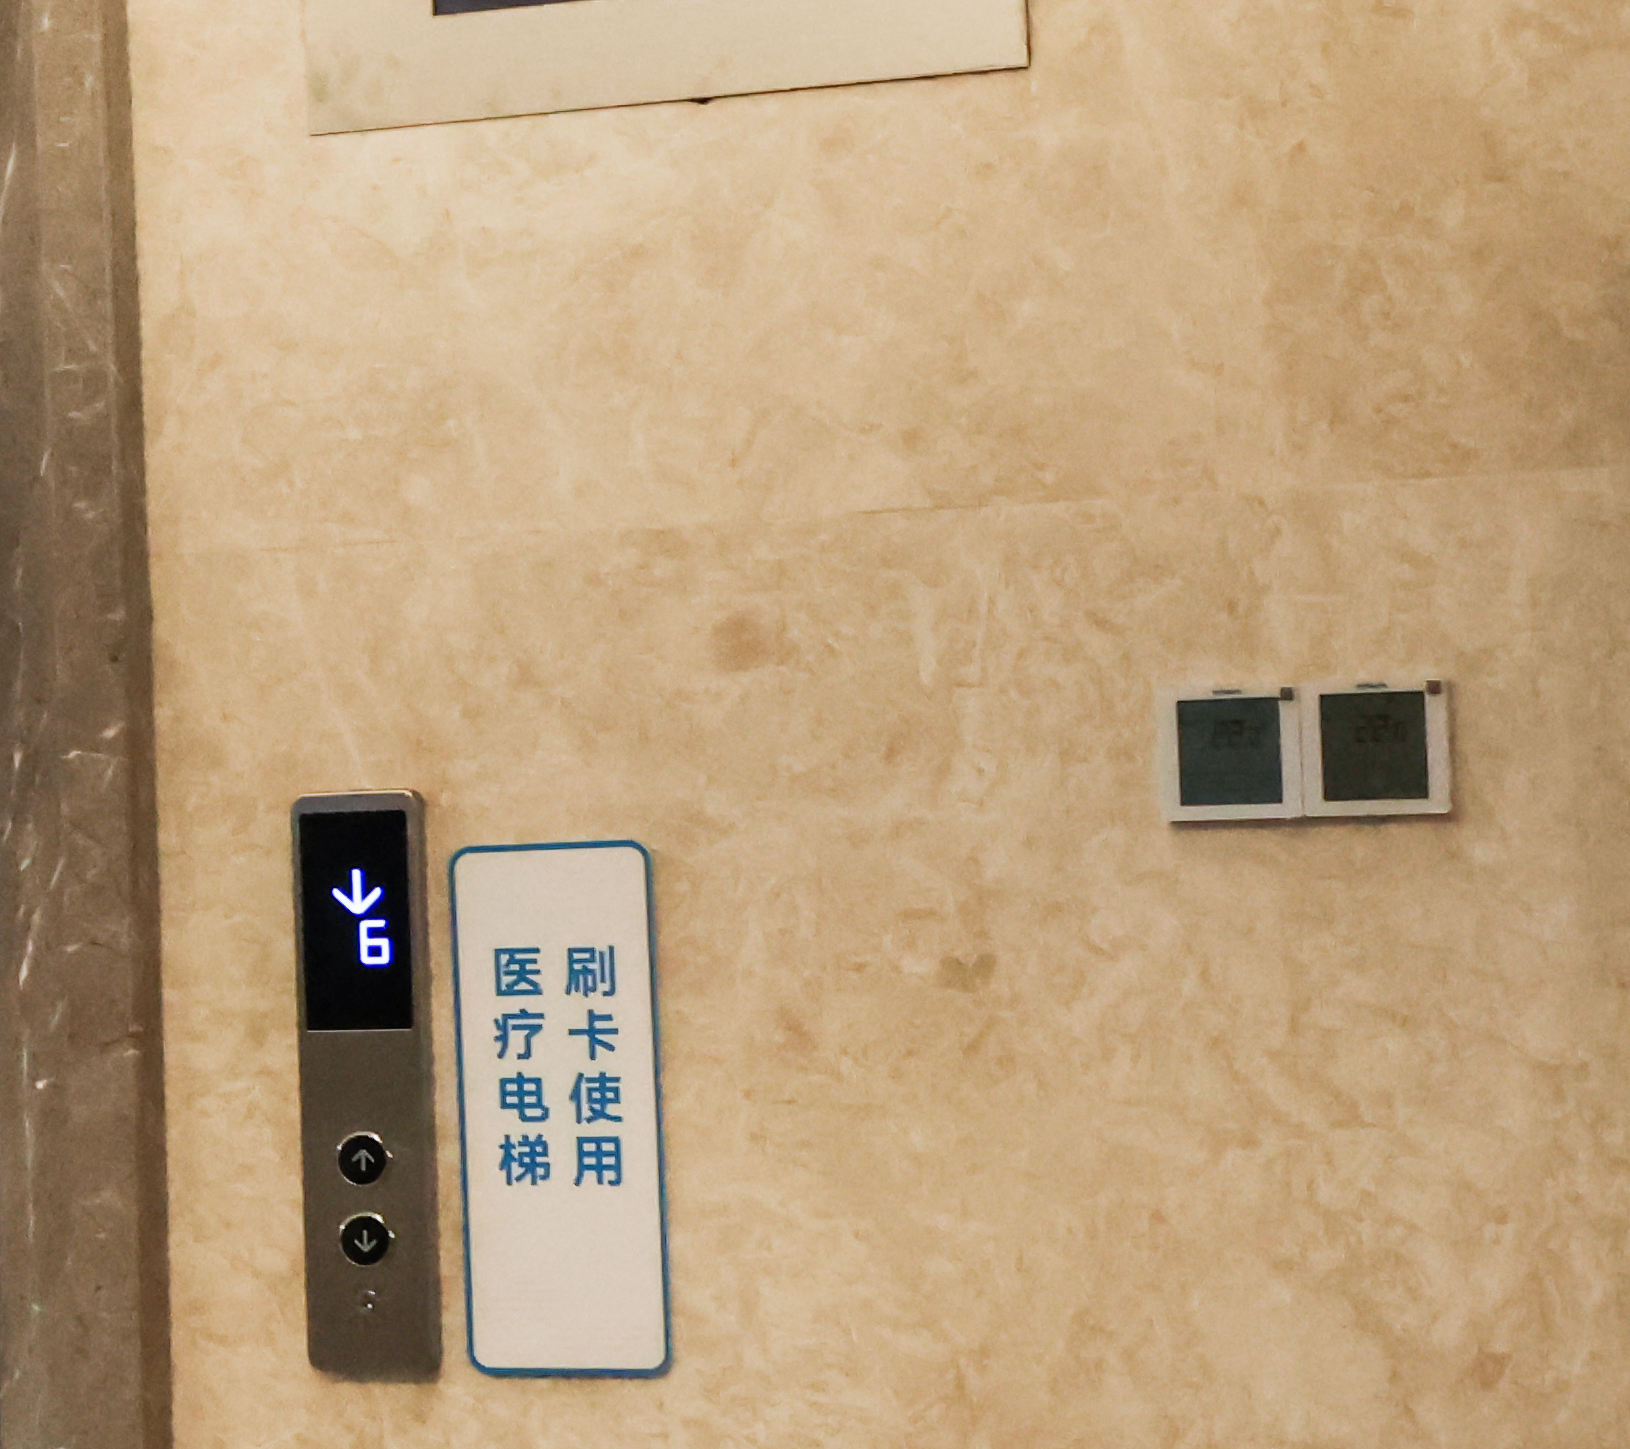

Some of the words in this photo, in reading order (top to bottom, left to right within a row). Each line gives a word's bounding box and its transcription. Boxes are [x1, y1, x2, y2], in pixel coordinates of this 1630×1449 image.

[358, 918, 392, 966] 6
[491, 945, 551, 1189] 医疗电梯
[564, 944, 624, 1189] 刷卡使用
